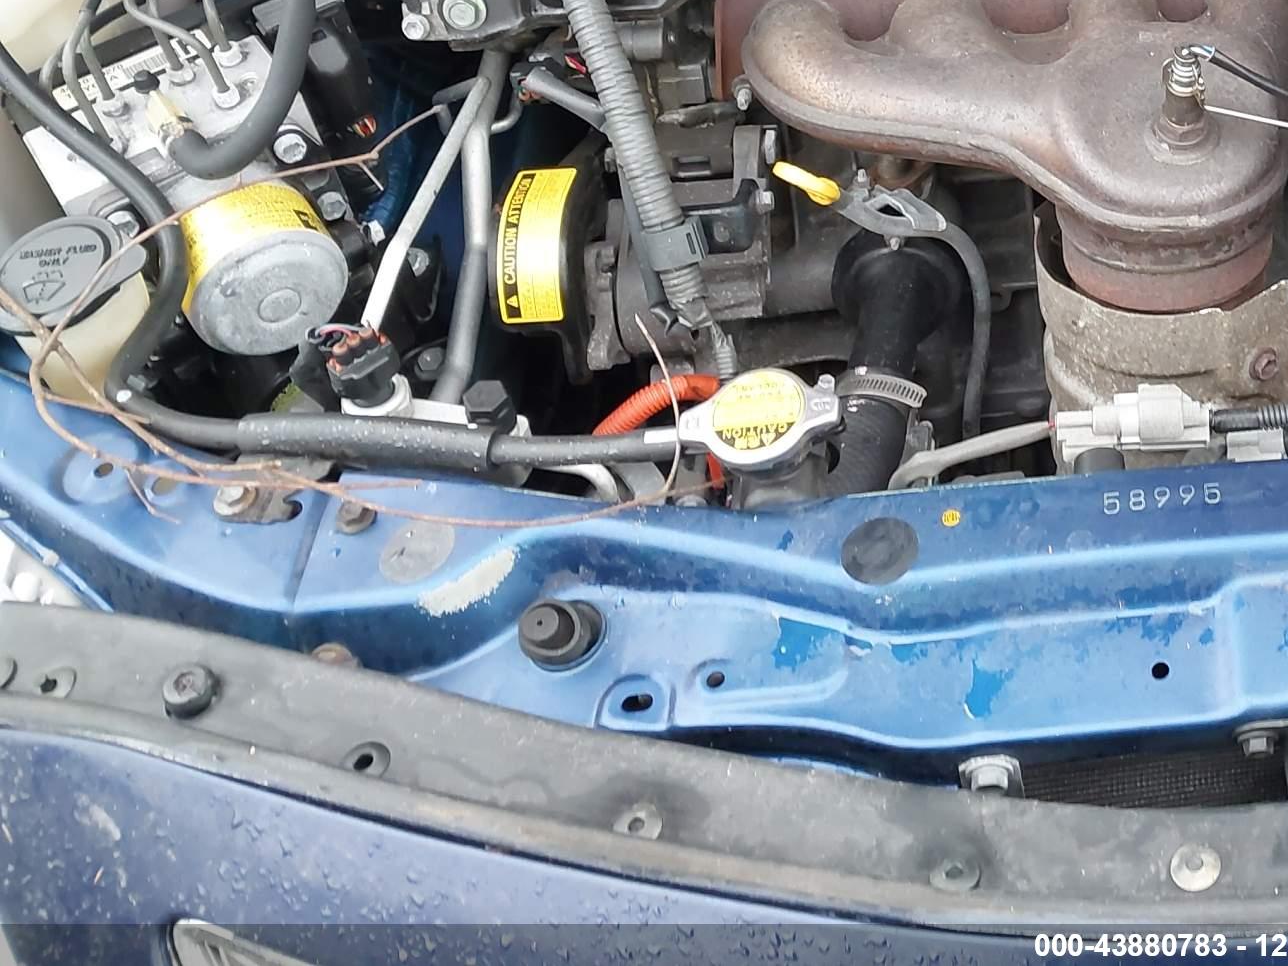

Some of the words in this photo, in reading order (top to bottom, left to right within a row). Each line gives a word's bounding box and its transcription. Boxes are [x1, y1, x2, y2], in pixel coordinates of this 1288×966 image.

[507, 177, 533, 224] ATTENTION
[20, 247, 62, 260] WASHER
[65, 244, 97, 255] FLUID
[39, 257, 70, 268] ONLY
[503, 226, 517, 285] CAUTION
[721, 422, 788, 440] CAUTION
[1103, 482, 1222, 515] 58995
